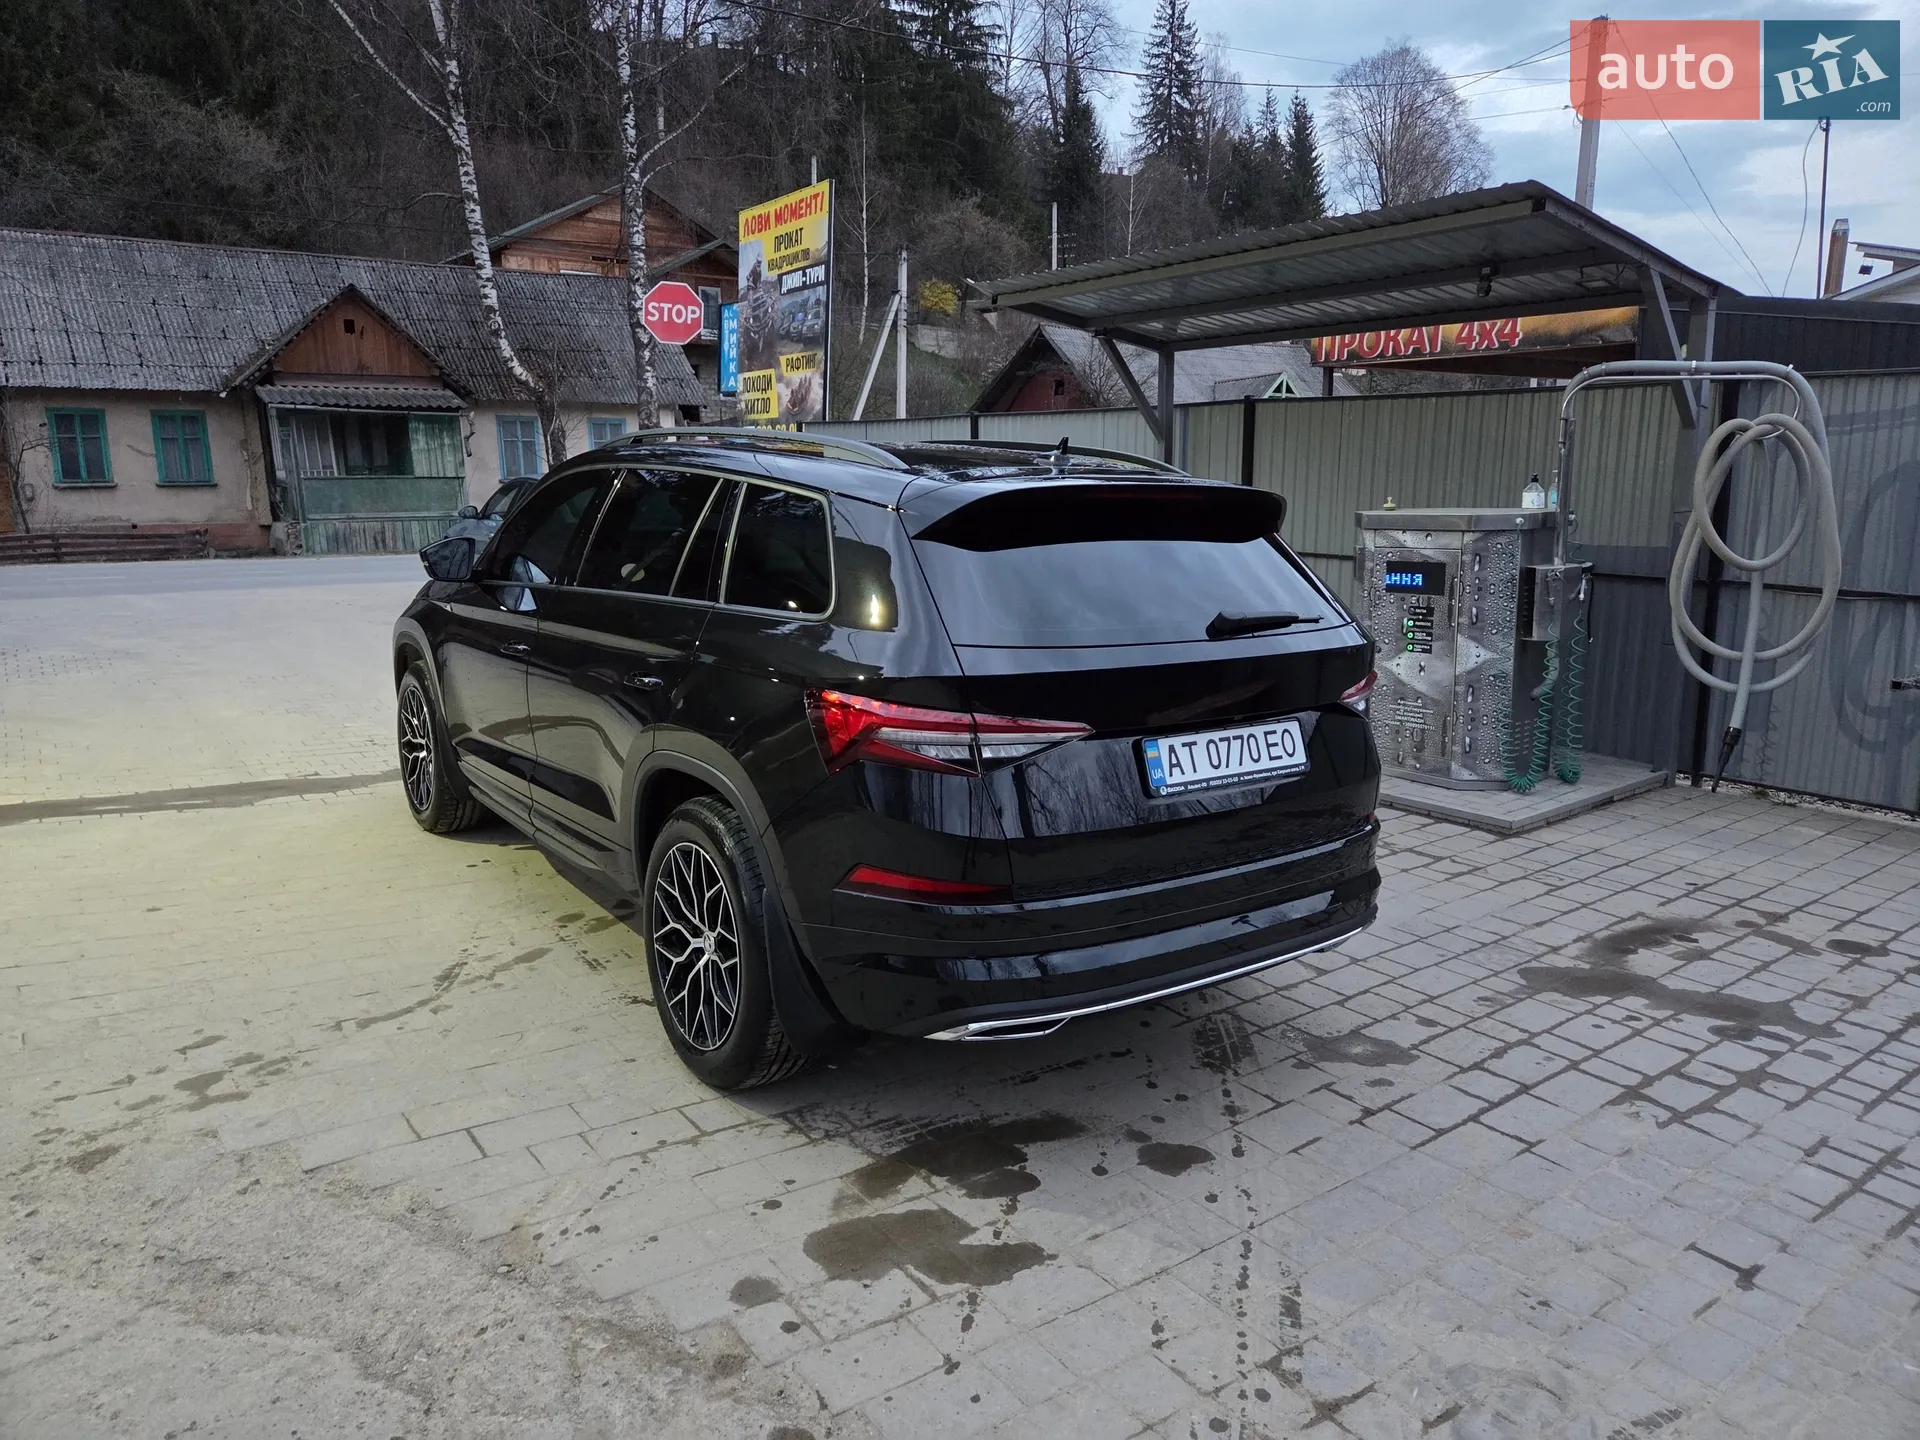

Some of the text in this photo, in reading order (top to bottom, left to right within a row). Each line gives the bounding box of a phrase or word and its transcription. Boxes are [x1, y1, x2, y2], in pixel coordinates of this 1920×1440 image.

[743, 191, 825, 238] ЛОВИ МОМЕНТ!
[774, 227, 804, 254] ПРОКАТ
[767, 248, 811, 273] КВАДРОЦИКЛІВ
[781, 264, 826, 294] ДЖИП-ТУРИ
[646, 302, 701, 325] STOP
[785, 353, 818, 373] РАФТИНГ
[1168, 741, 1198, 778] AT
[1206, 733, 1262, 770] 0770
[1264, 728, 1296, 762] EO
[1151, 768, 1165, 780] UA
